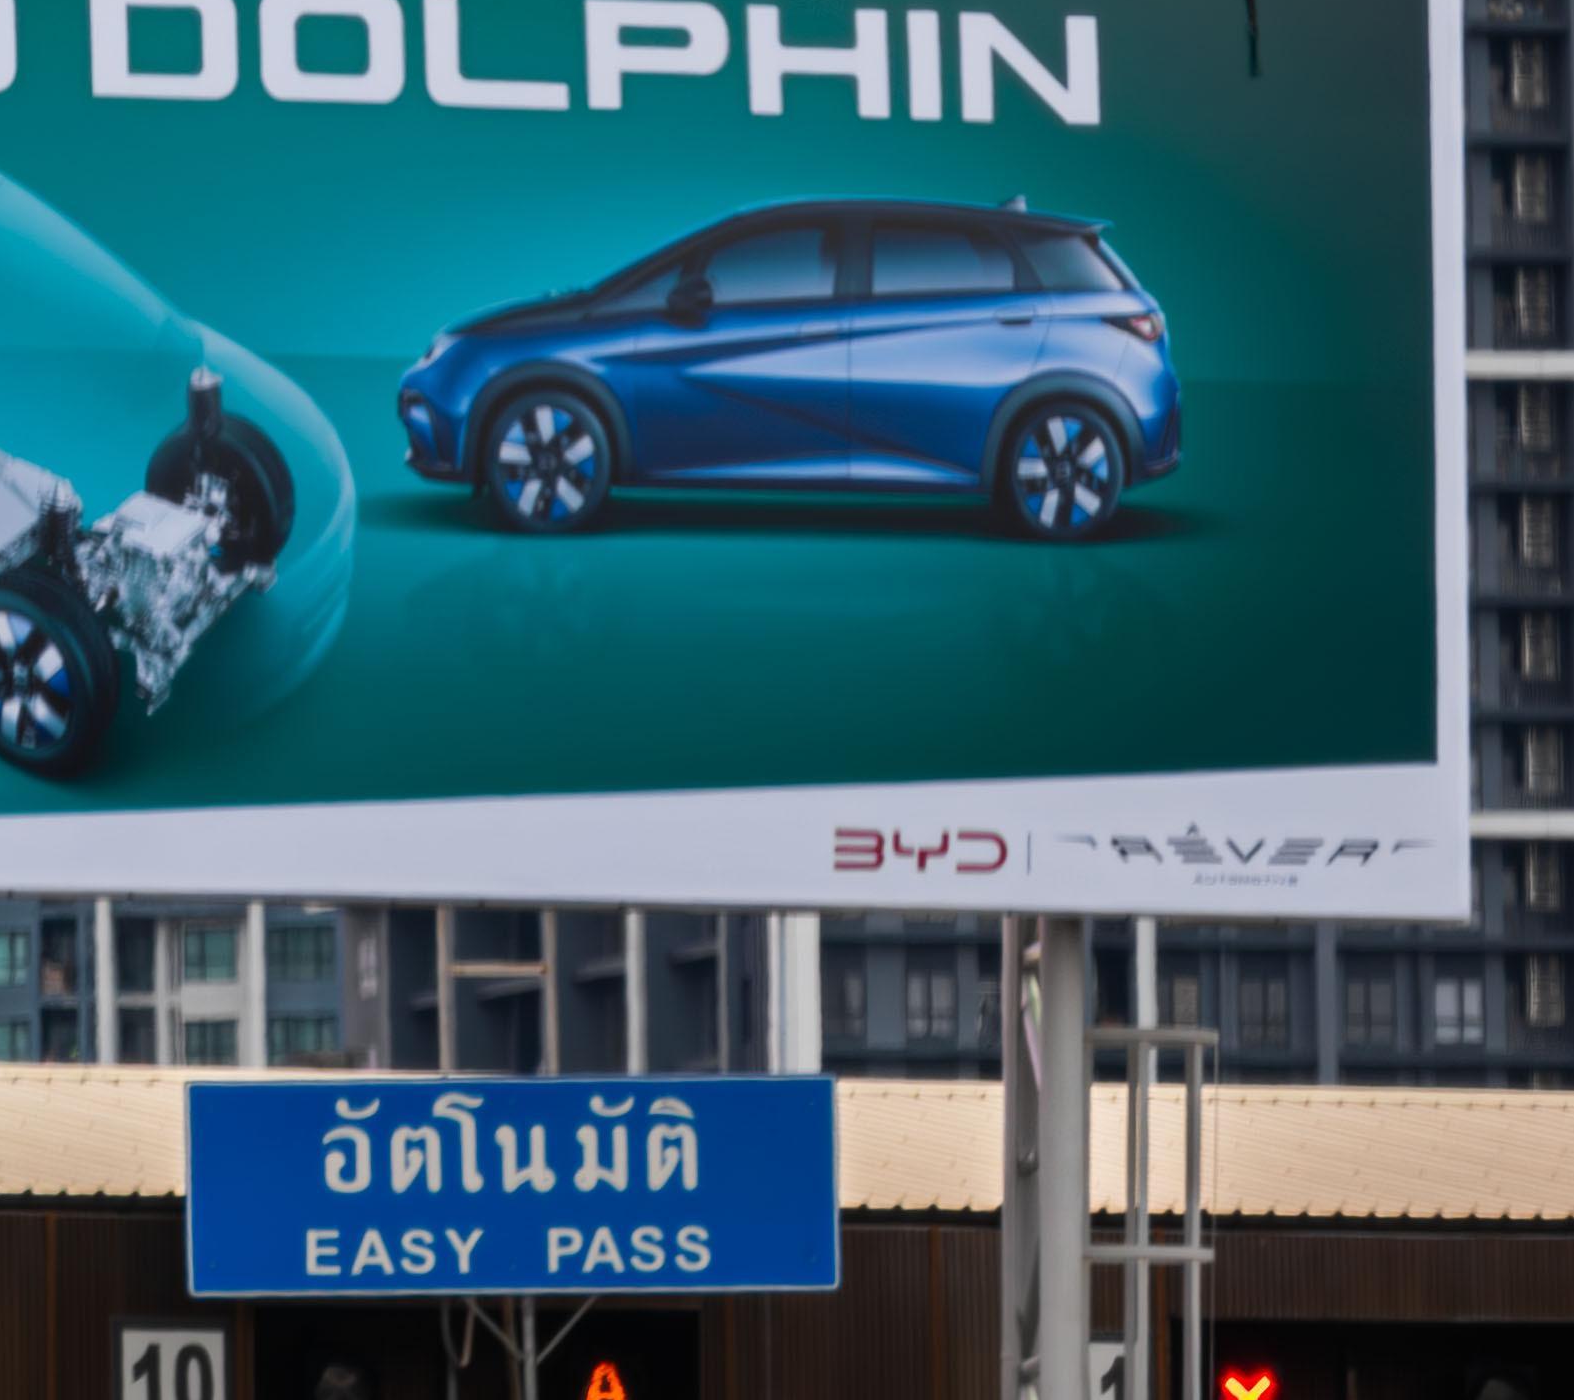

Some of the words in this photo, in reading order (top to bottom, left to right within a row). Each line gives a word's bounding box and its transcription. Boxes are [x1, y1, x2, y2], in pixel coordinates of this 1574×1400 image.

[834, 827, 1008, 873] BYD
[323, 1093, 699, 1193] อัตโนมัติ
[307, 1230, 484, 1276] EASY
[547, 1226, 712, 1273] PASS
